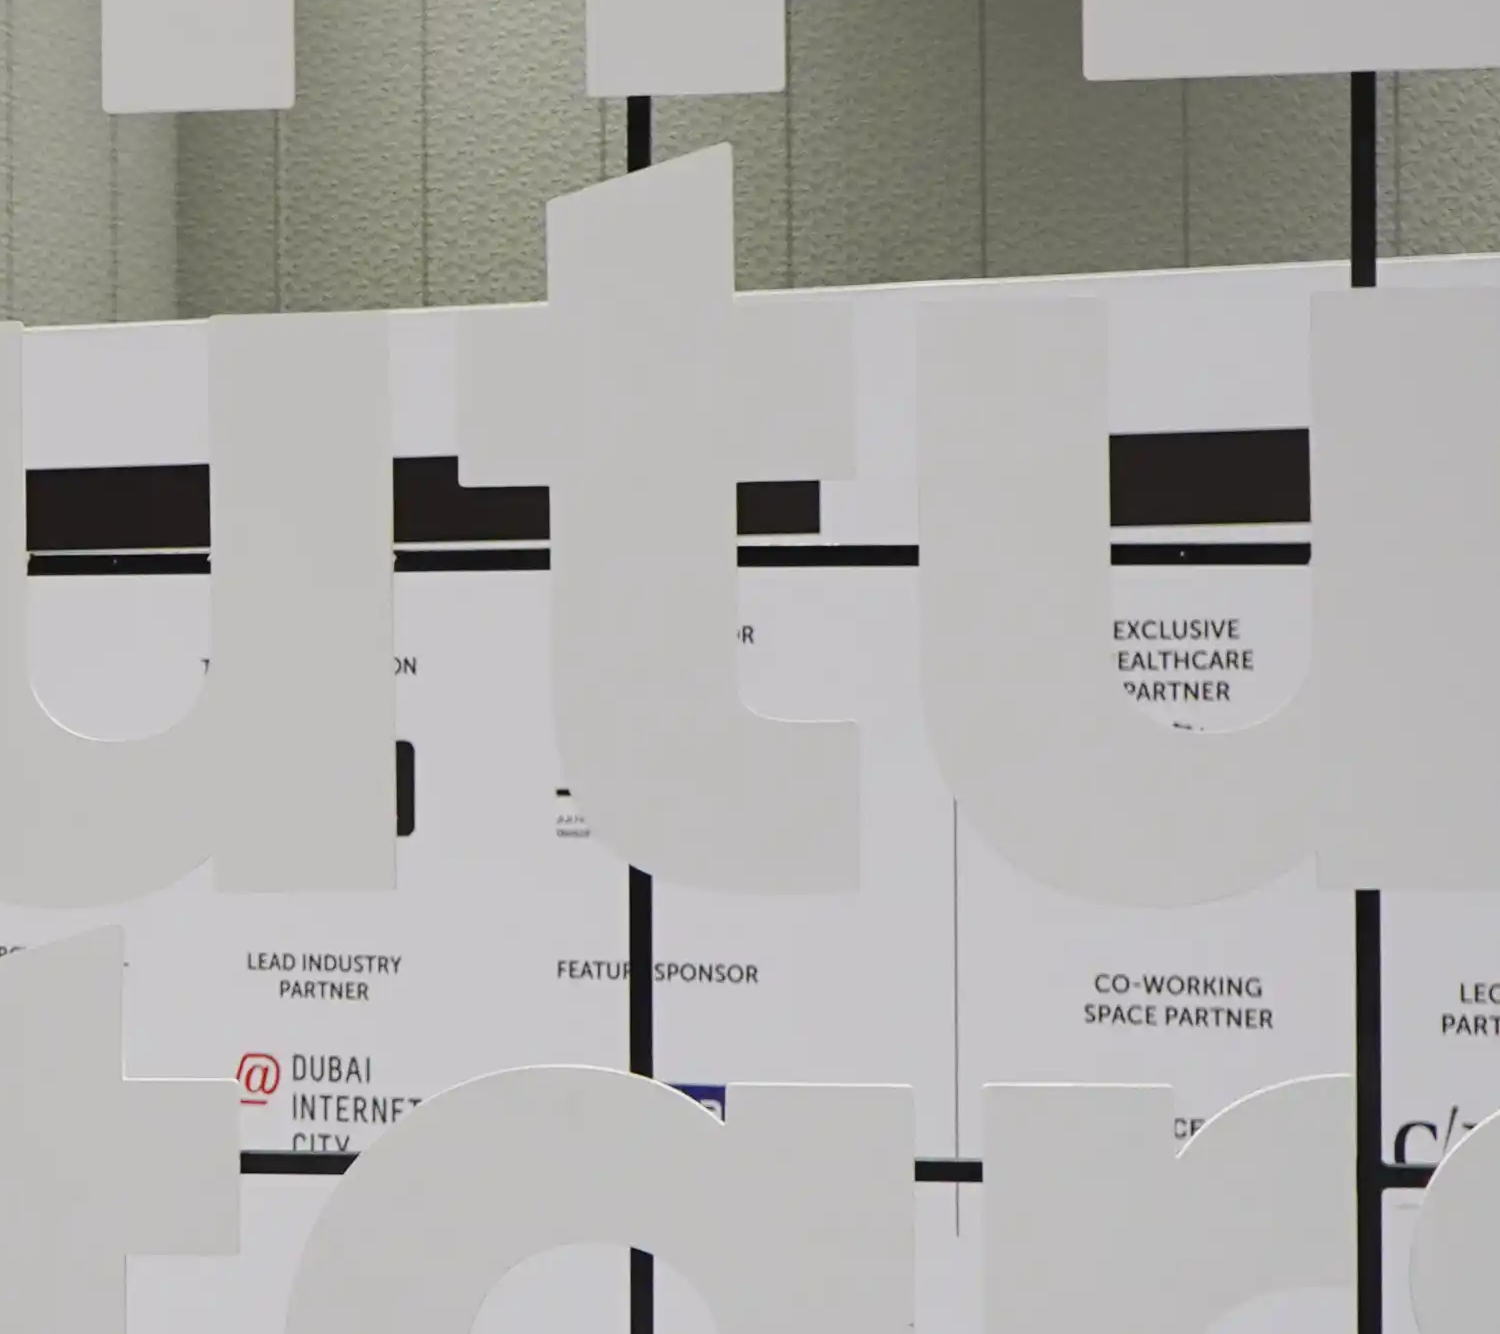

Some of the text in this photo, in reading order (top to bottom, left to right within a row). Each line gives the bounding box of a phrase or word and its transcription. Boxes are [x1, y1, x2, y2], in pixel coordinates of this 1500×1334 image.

[1113, 619, 1241, 640] EXCLUSIVE
[1113, 651, 1255, 671] EALTHCARE
[248, 952, 402, 975] LEAD INDUSTRY
[654, 963, 760, 984] SPONSOR
[279, 981, 370, 1001] PARTNER
[1094, 974, 1262, 997] CO-WORKING
[1084, 1004, 1273, 1029] SPACE PARTNER
[292, 1055, 371, 1083] DUBAI
